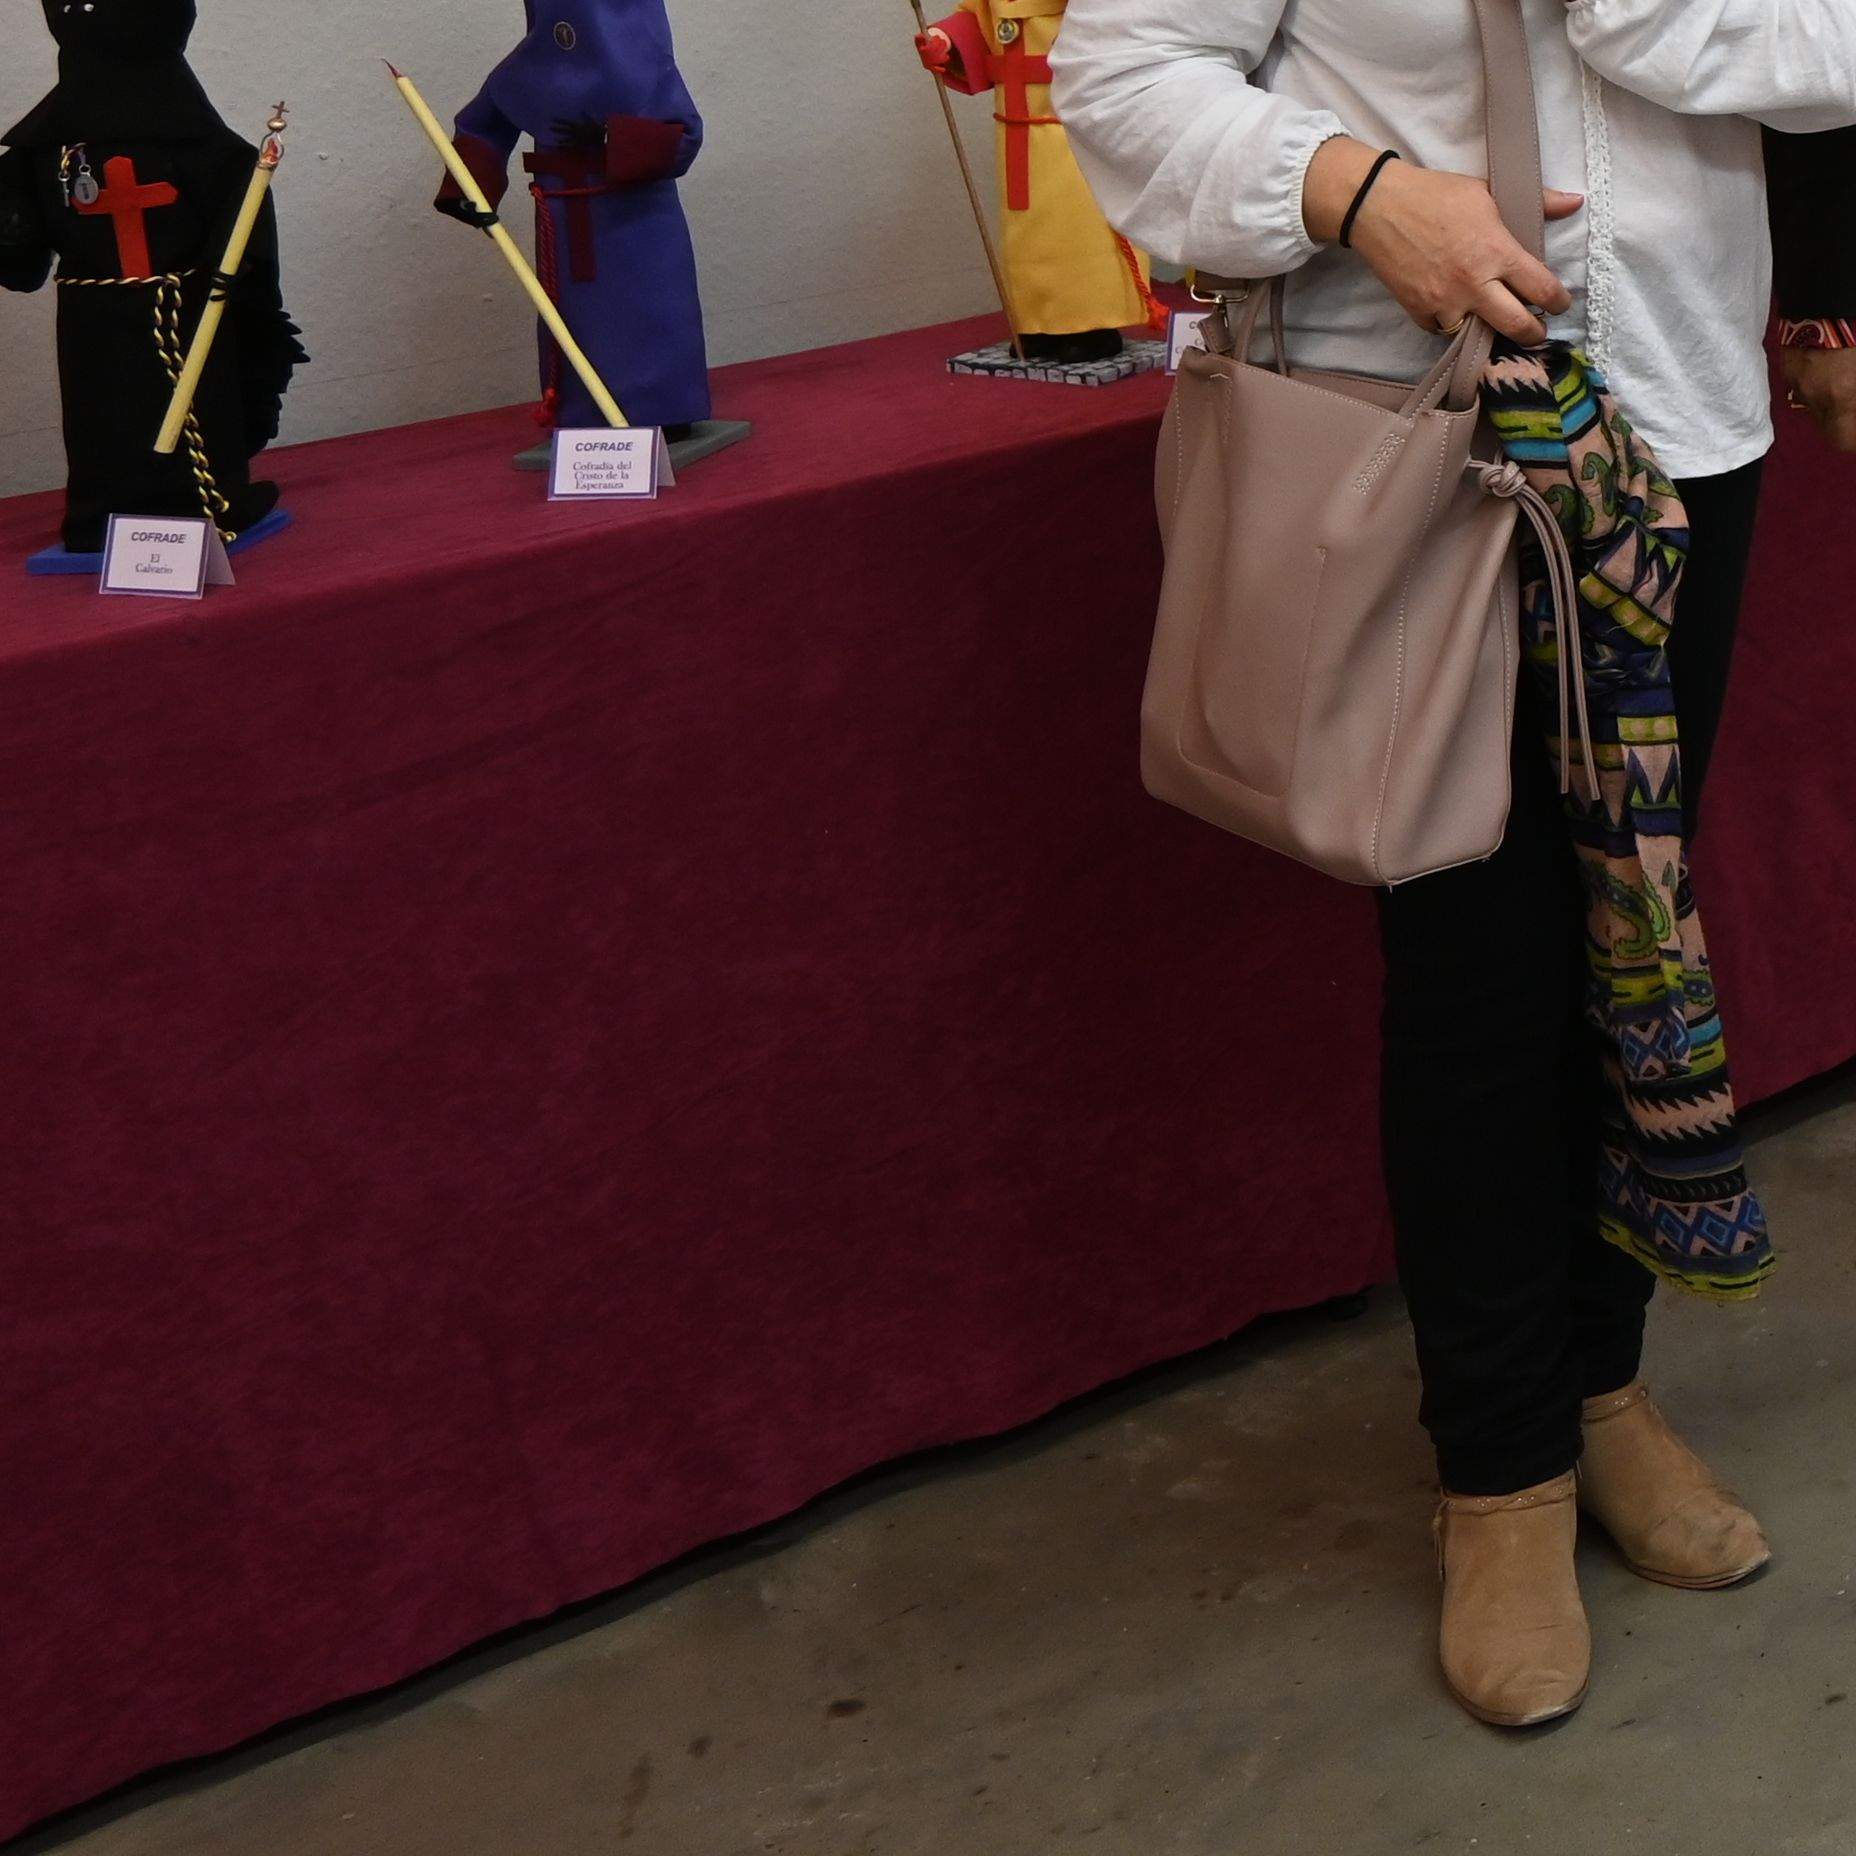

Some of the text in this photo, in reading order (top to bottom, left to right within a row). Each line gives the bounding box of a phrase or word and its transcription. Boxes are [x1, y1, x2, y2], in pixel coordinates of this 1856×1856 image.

[574, 441, 634, 452] COFRADE
[616, 460, 632, 470] del
[574, 470, 630, 480] Cristo de la
[575, 480, 625, 491] Esperanza
[131, 531, 187, 544] COFRADE
[150, 553, 160, 563] El
[135, 563, 174, 574] Calvario
